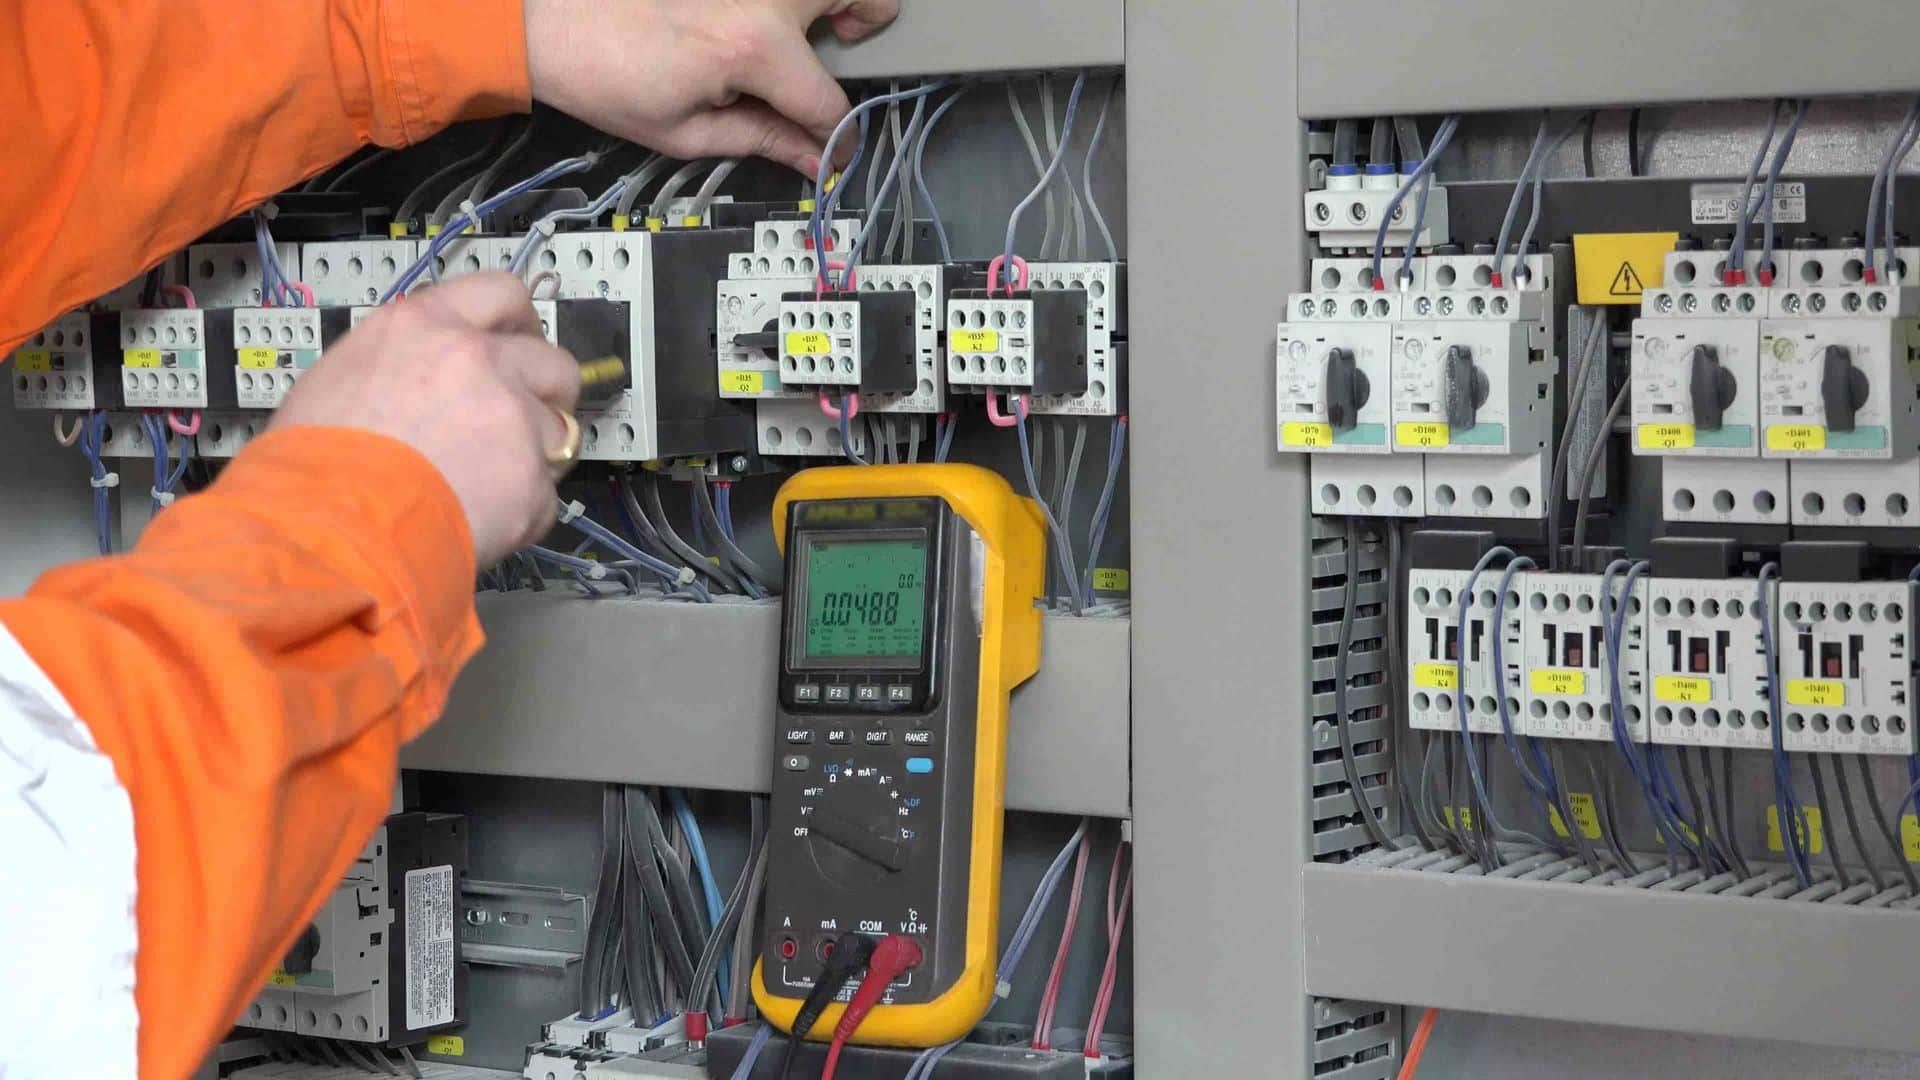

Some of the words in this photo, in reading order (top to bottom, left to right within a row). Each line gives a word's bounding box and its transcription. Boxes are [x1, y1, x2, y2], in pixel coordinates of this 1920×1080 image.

[800, 688, 811, 697] F1
[831, 688, 841, 697] F2
[861, 688, 873, 697] F3
[892, 688, 904, 698] F4
[787, 731, 808, 740] LIGHT
[829, 731, 844, 740] BAR
[866, 732, 887, 741] DIGIT
[905, 733, 929, 743] RANGE
[898, 807, 909, 816] Hz
[793, 827, 809, 837] OFF
[783, 916, 791, 927] A
[821, 919, 836, 929] mA
[860, 920, 882, 932] COM
